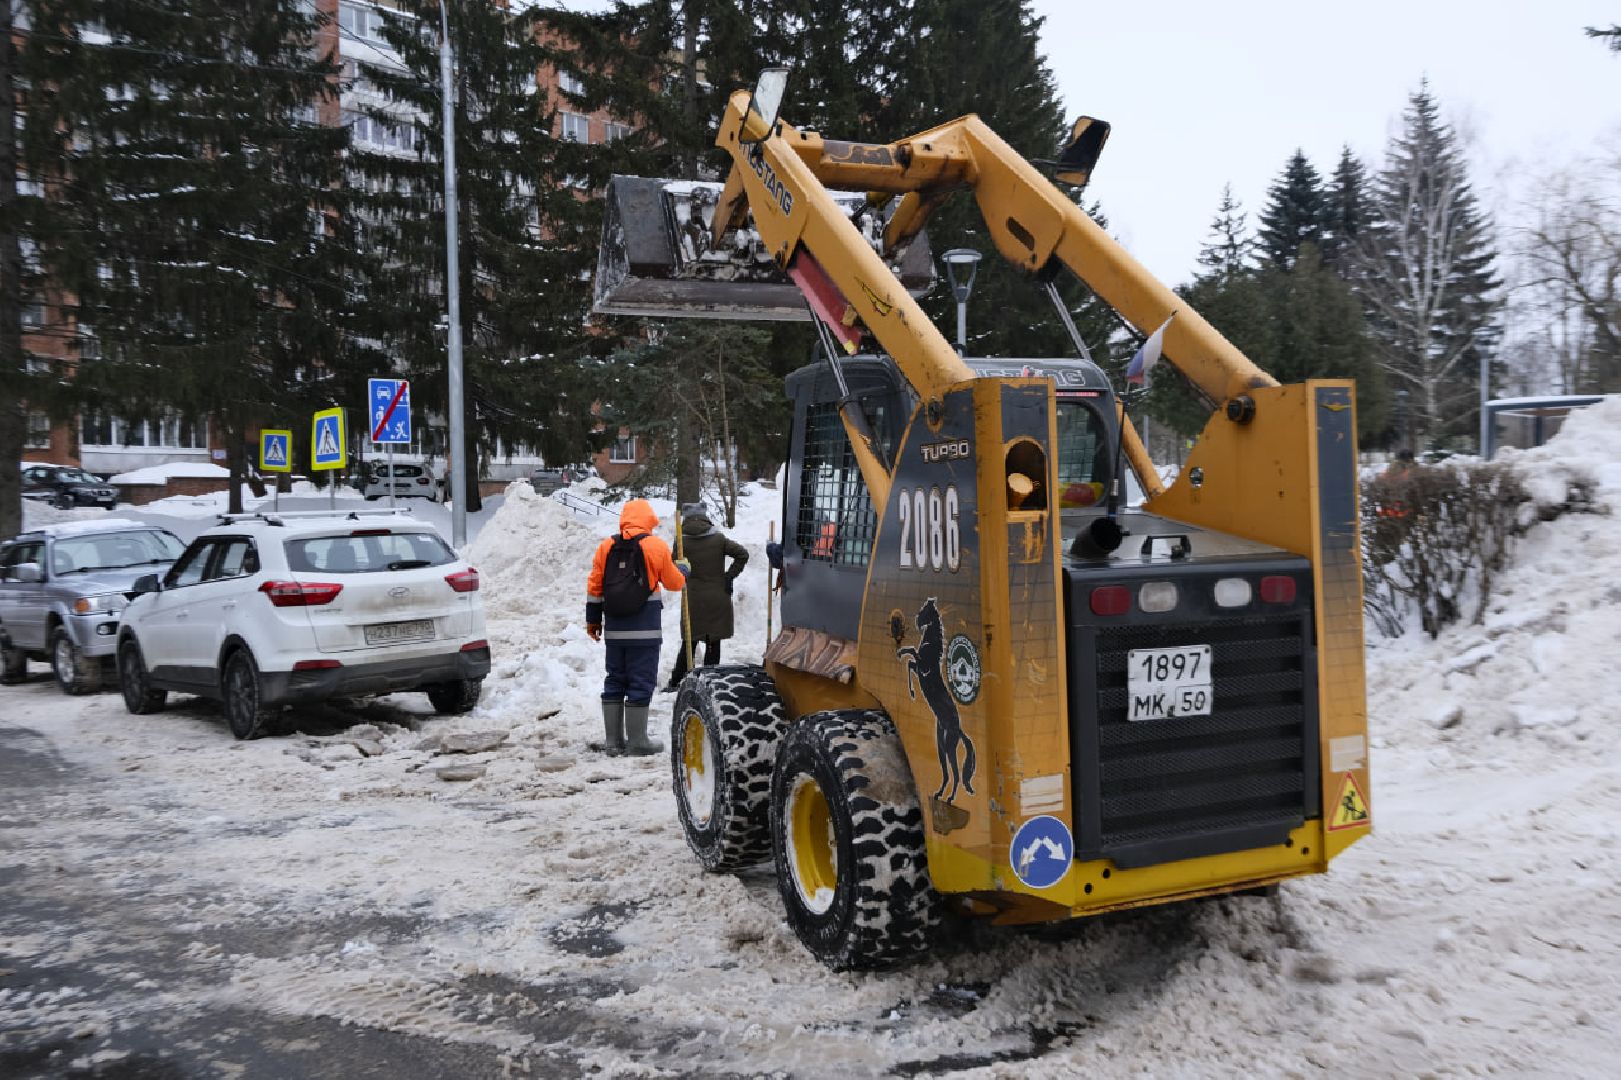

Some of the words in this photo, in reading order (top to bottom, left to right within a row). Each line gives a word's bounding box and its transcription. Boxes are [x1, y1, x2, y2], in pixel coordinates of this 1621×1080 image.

[920, 440, 969, 463] TURBO
[899, 485, 960, 573] 2086
[1141, 652, 1201, 683] 1897
[1181, 691, 1206, 712] 50
